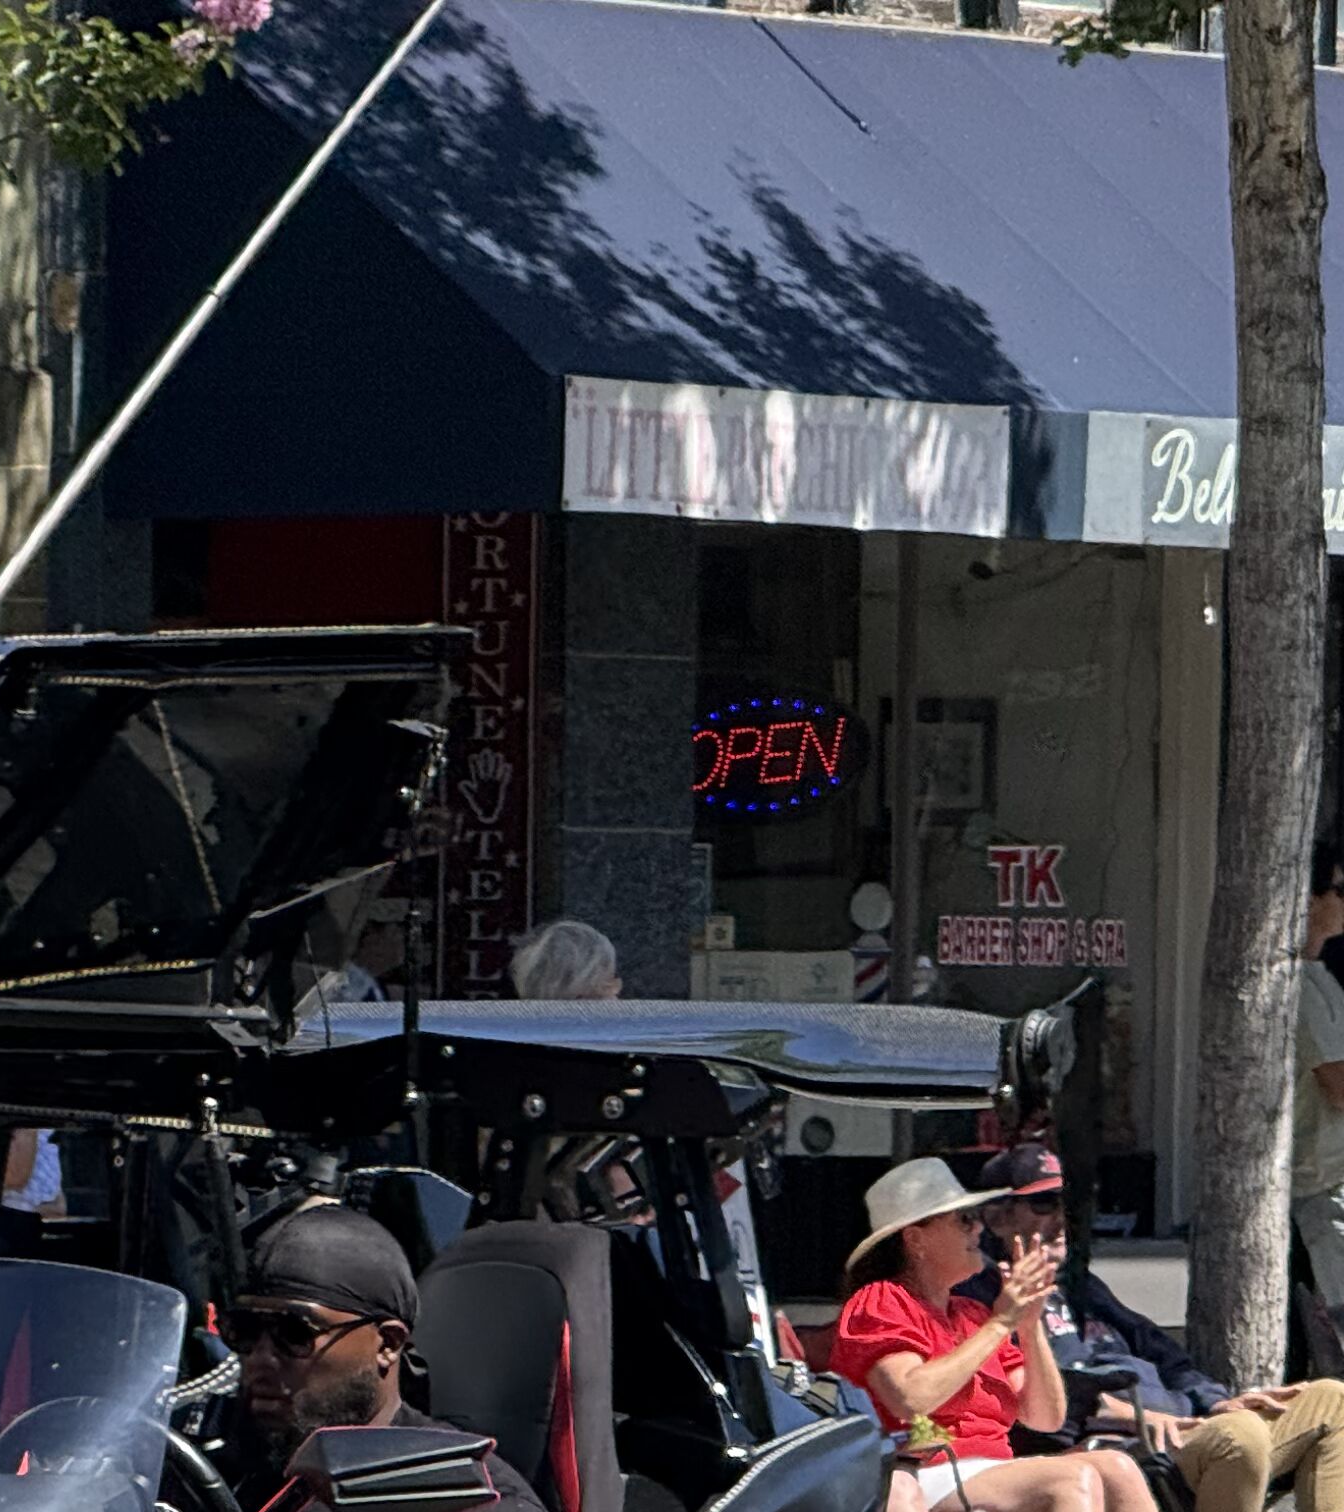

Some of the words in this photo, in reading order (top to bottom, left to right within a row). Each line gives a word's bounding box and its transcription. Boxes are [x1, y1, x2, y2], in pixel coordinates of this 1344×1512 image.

[988, 845, 1064, 907] TK
[465, 832, 504, 1000] TELL
[938, 915, 1012, 965] BARBER
[1018, 918, 1068, 967] SHOP
[1073, 918, 1088, 967] &
[1092, 919, 1128, 968] SPA
